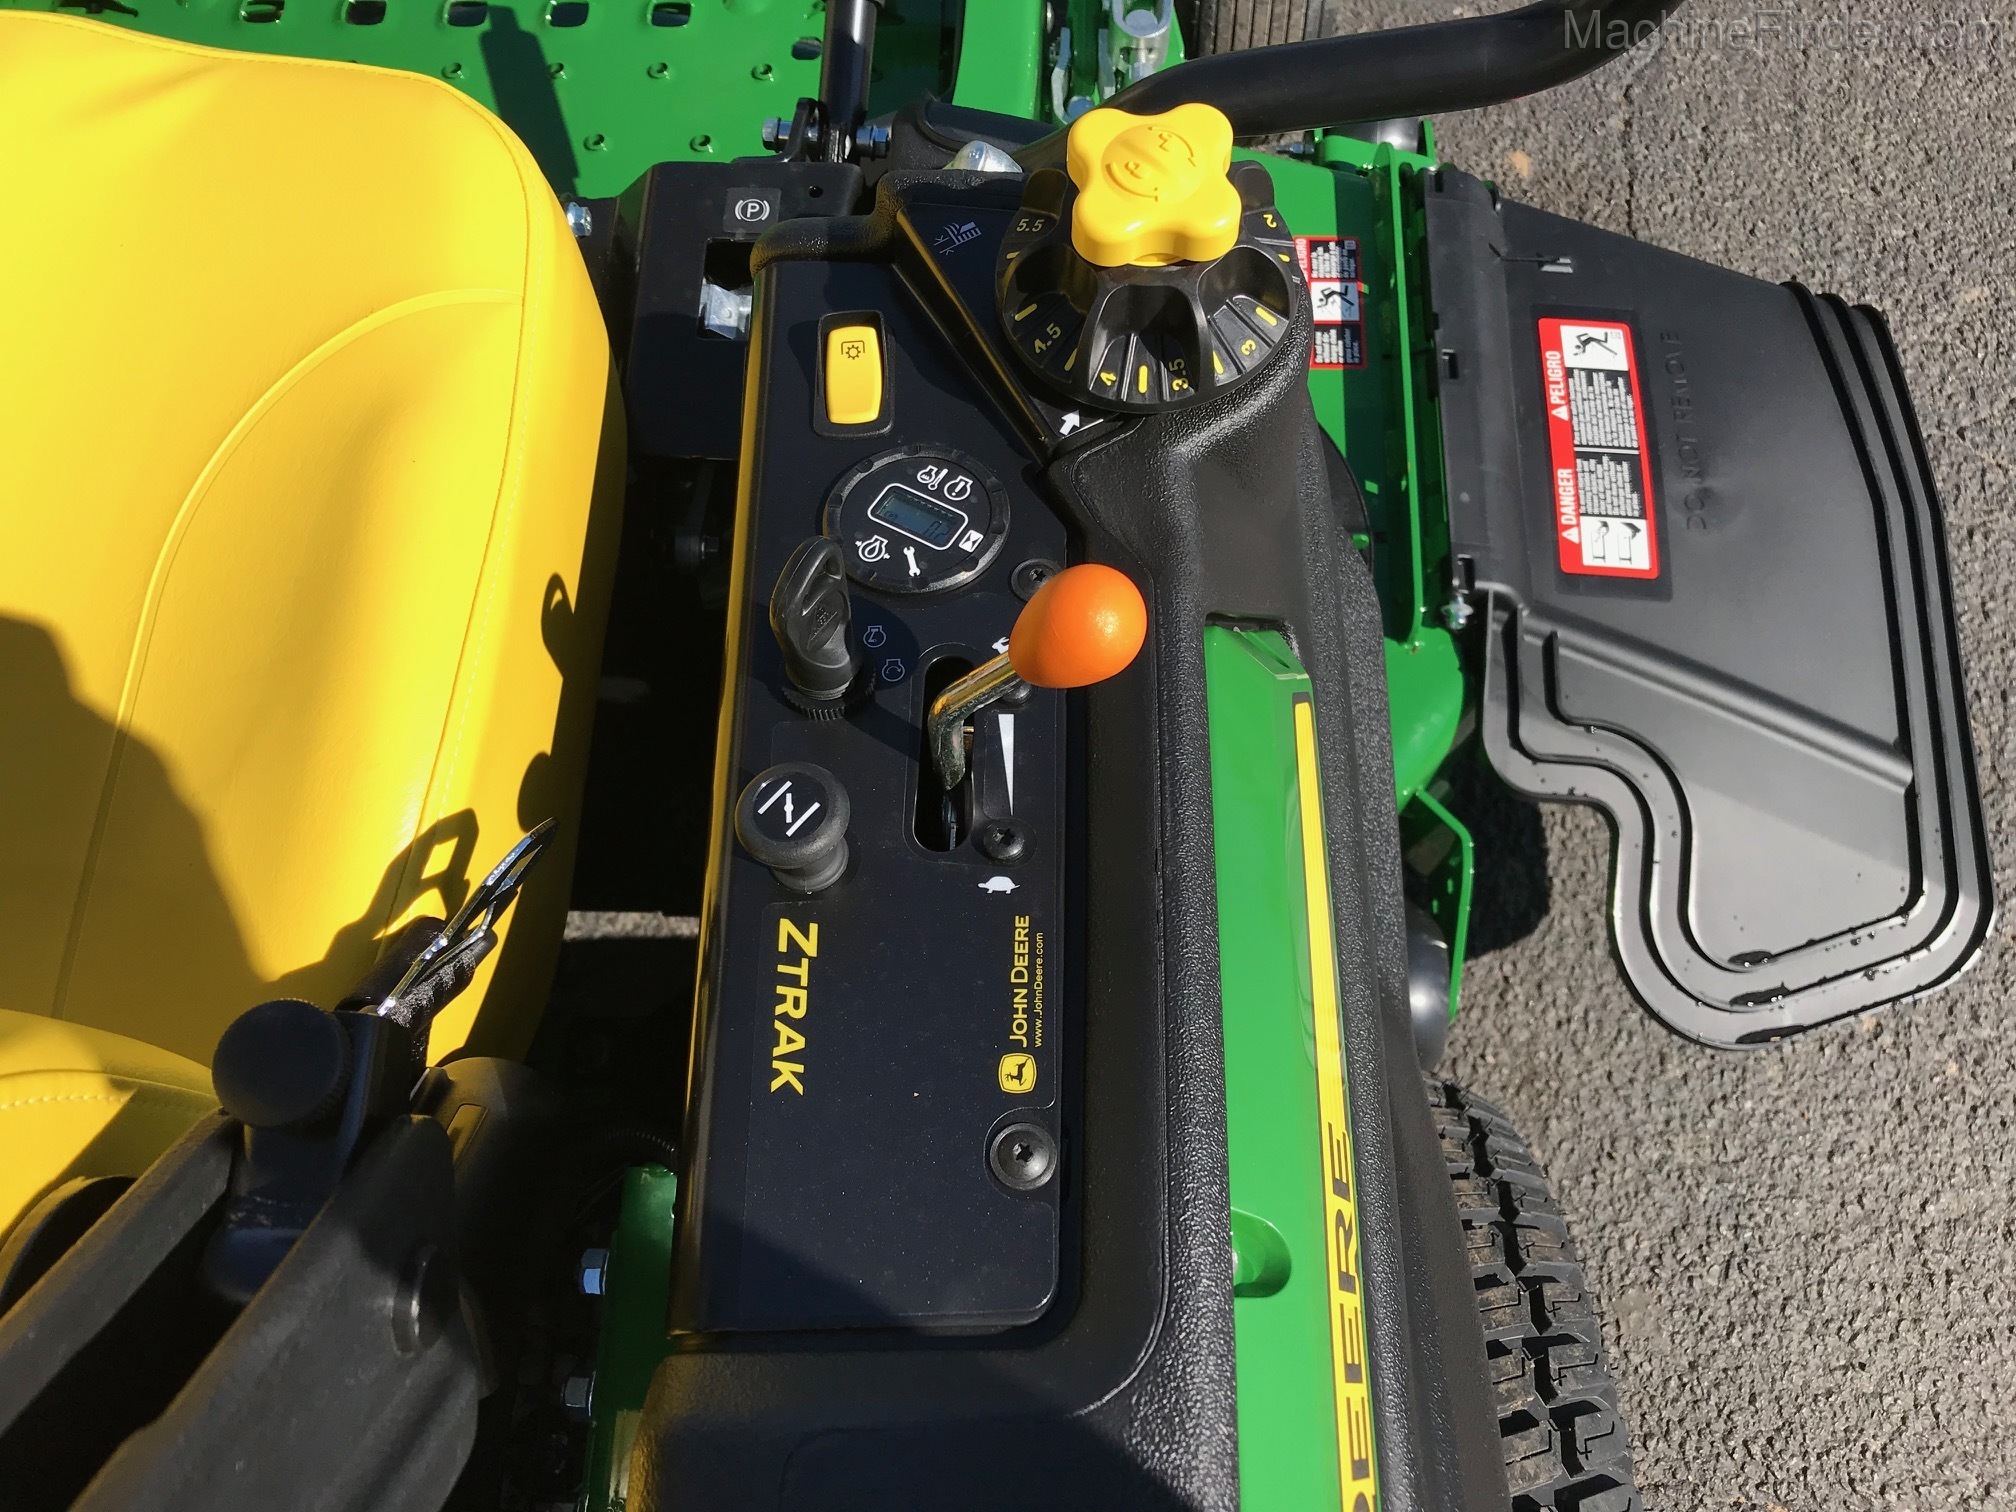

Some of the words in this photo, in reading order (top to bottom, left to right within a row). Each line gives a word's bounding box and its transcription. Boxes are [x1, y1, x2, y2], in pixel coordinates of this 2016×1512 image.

[1015, 218, 1045, 232] 5.5
[1262, 213, 1278, 228] 2
[1033, 323, 1062, 354] 4.5
[1240, 339, 1257, 355] 3
[1099, 371, 1117, 387] 4
[1169, 357, 1190, 391] 3.5
[1545, 350, 1569, 405] PELIGRO
[1557, 468, 1579, 525] DANGER
[1010, 915, 1030, 984] DEERE
[769, 917, 819, 1096] ZTRAK
[1033, 931, 1044, 1048] www.JohnDeere.com
[1009, 988, 1028, 1048] JOHN
[1328, 1121, 1377, 1512] EERE
